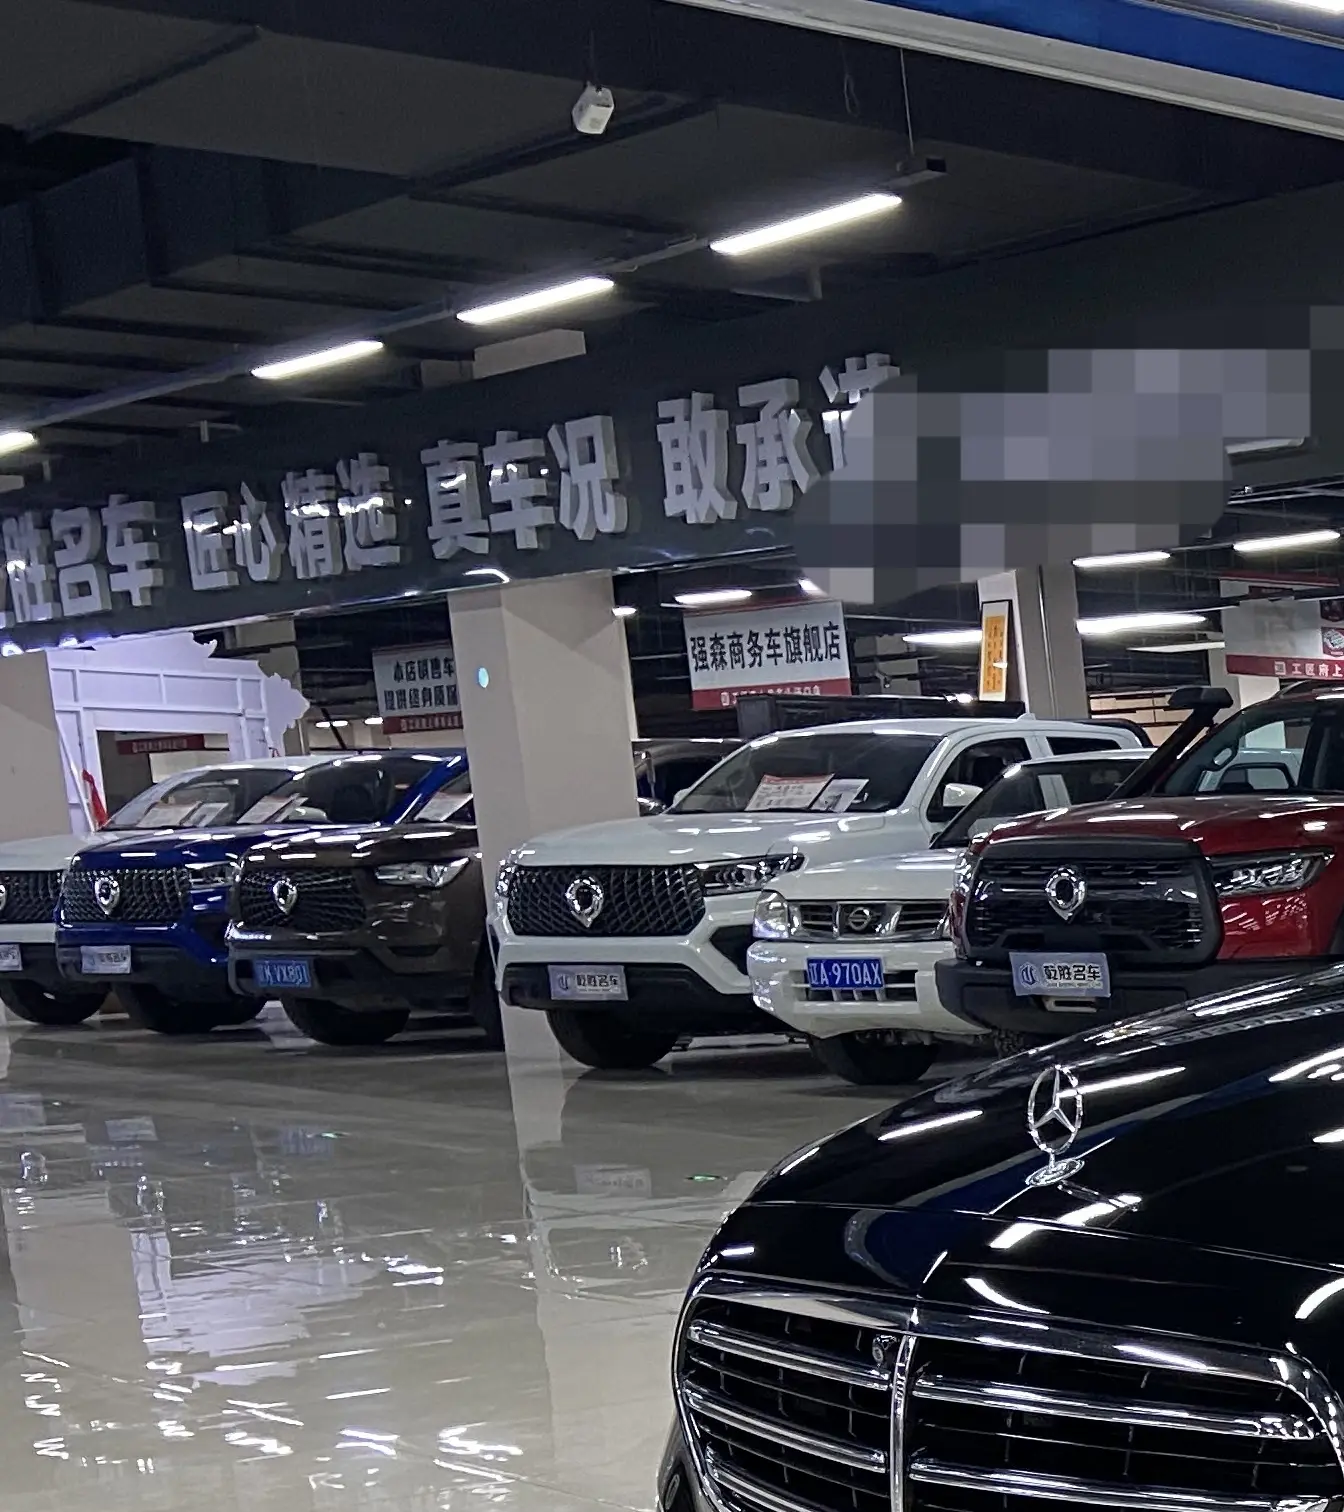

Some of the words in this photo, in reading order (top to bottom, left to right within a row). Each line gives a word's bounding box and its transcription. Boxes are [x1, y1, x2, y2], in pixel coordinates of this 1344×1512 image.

[2, 494, 164, 627] 胜名车
[181, 453, 402, 592] 匠心精选
[421, 415, 628, 560] 真车况
[690, 620, 842, 673] 强森商务车旗舰店
